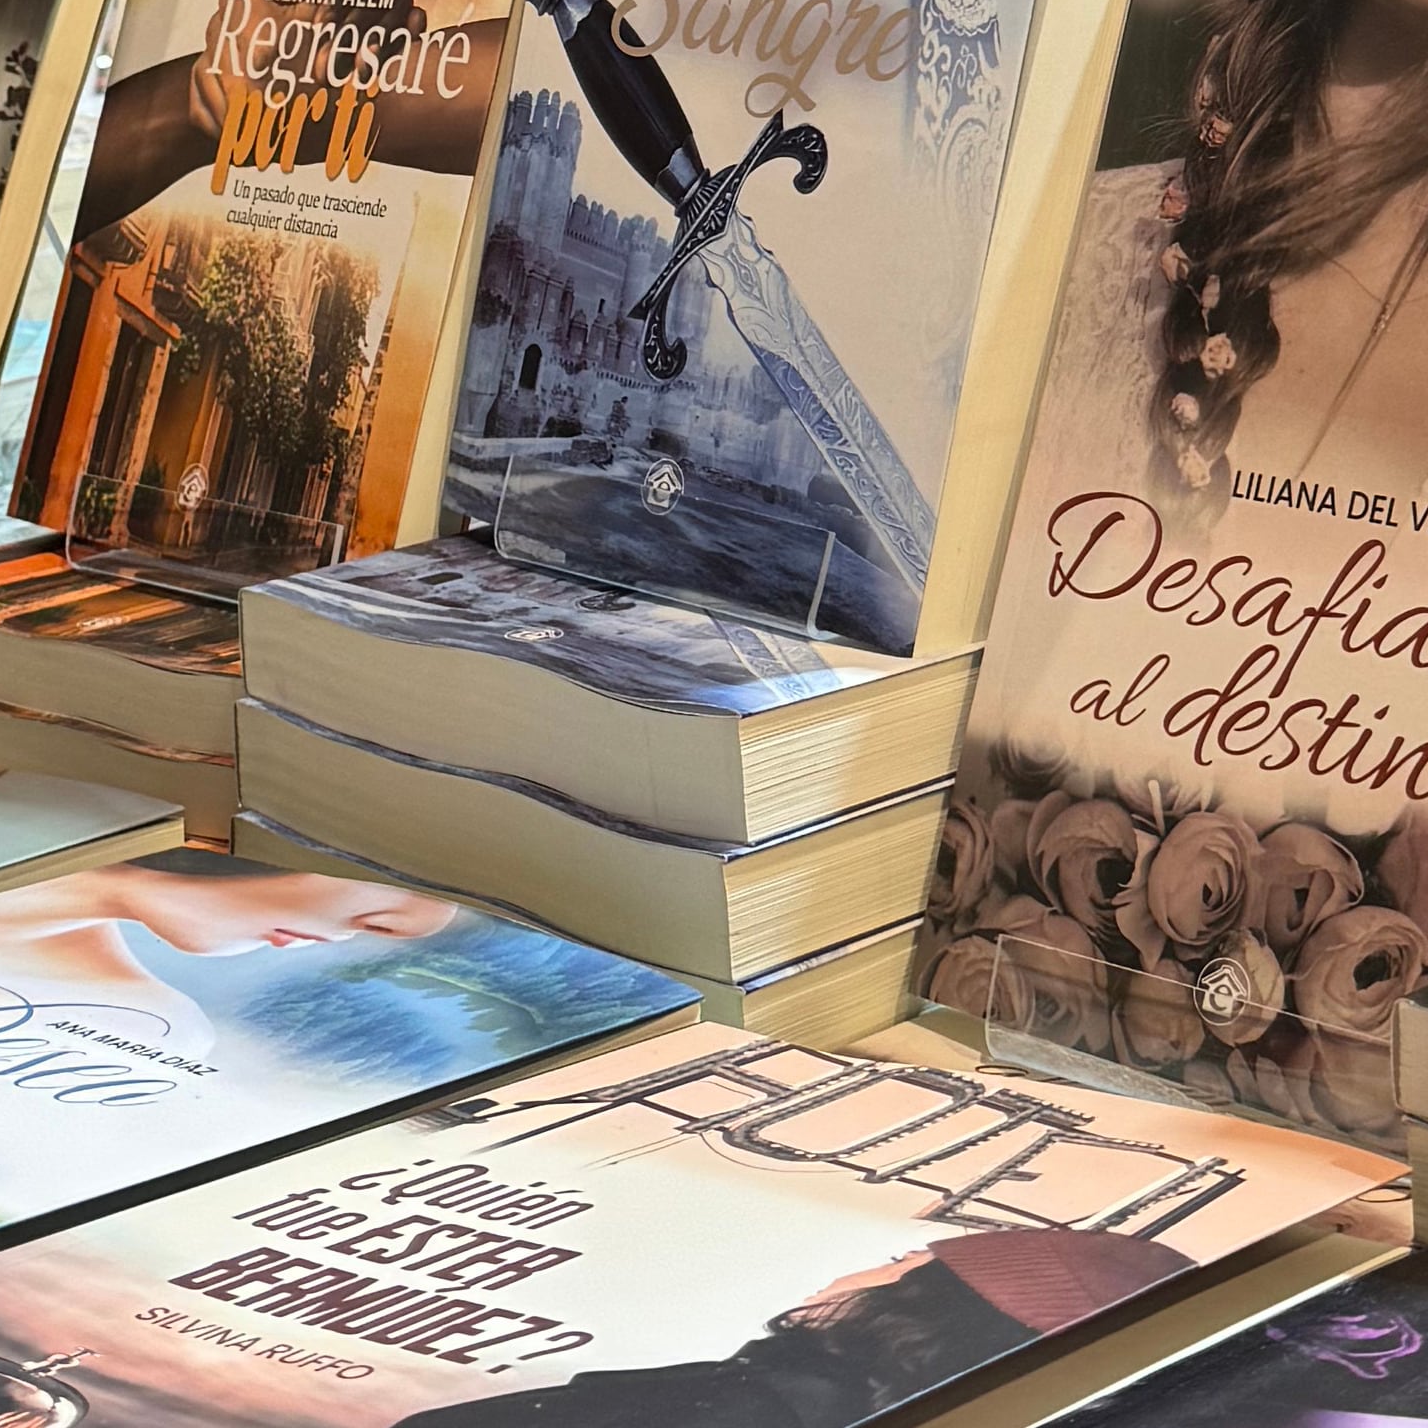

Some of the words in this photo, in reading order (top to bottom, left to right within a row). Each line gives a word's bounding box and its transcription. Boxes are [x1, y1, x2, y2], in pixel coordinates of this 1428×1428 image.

[211, 83, 329, 196] por
[226, 207, 283, 234] cualquier
[283, 213, 339, 239] distancia
[232, 179, 251, 200] Un
[252, 184, 295, 208] pasado
[297, 191, 322, 212] que
[322, 193, 388, 219] trasciende
[1230, 469, 1339, 518] LILIANA
[1346, 490, 1400, 527] DEL
[1070, 653, 1171, 727] al
[46, 1019, 91, 1040] ANA
[91, 1032, 166, 1063] MARÍA
[158, 1054, 221, 1079] DÍAZ
[338, 1158, 595, 1231] ¿Quién
[231, 1187, 369, 1240] fue
[325, 1214, 584, 1291] ESTER
[134, 1305, 264, 1356] SILVINA
[255, 1342, 376, 1381] RUFFO
[168, 1246, 595, 1375] BERMÚDEZ?
